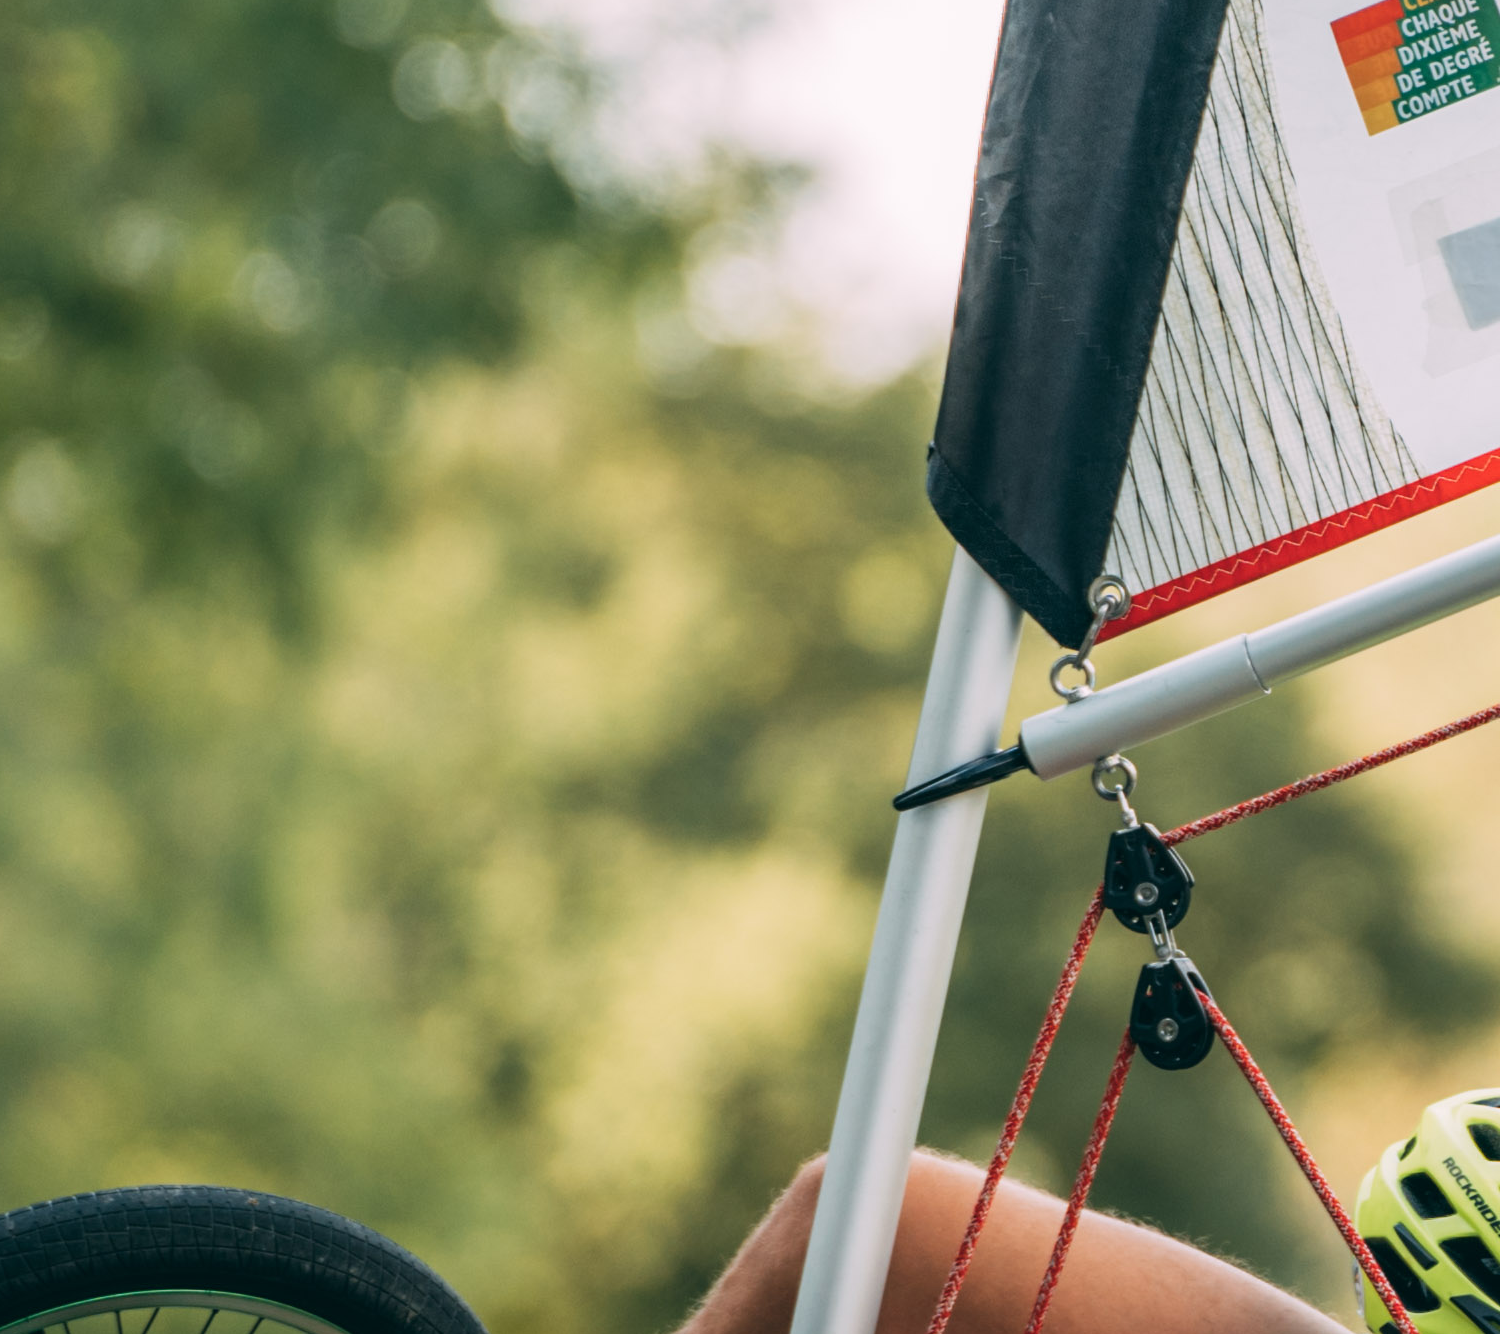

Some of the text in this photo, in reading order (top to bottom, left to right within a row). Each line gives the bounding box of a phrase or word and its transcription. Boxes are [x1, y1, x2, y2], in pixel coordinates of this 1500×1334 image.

[1397, 36, 1494, 94] DE DEGRÉ
[1398, 19, 1481, 66] DIXIÈME
[1397, 75, 1477, 119] COMPTE
